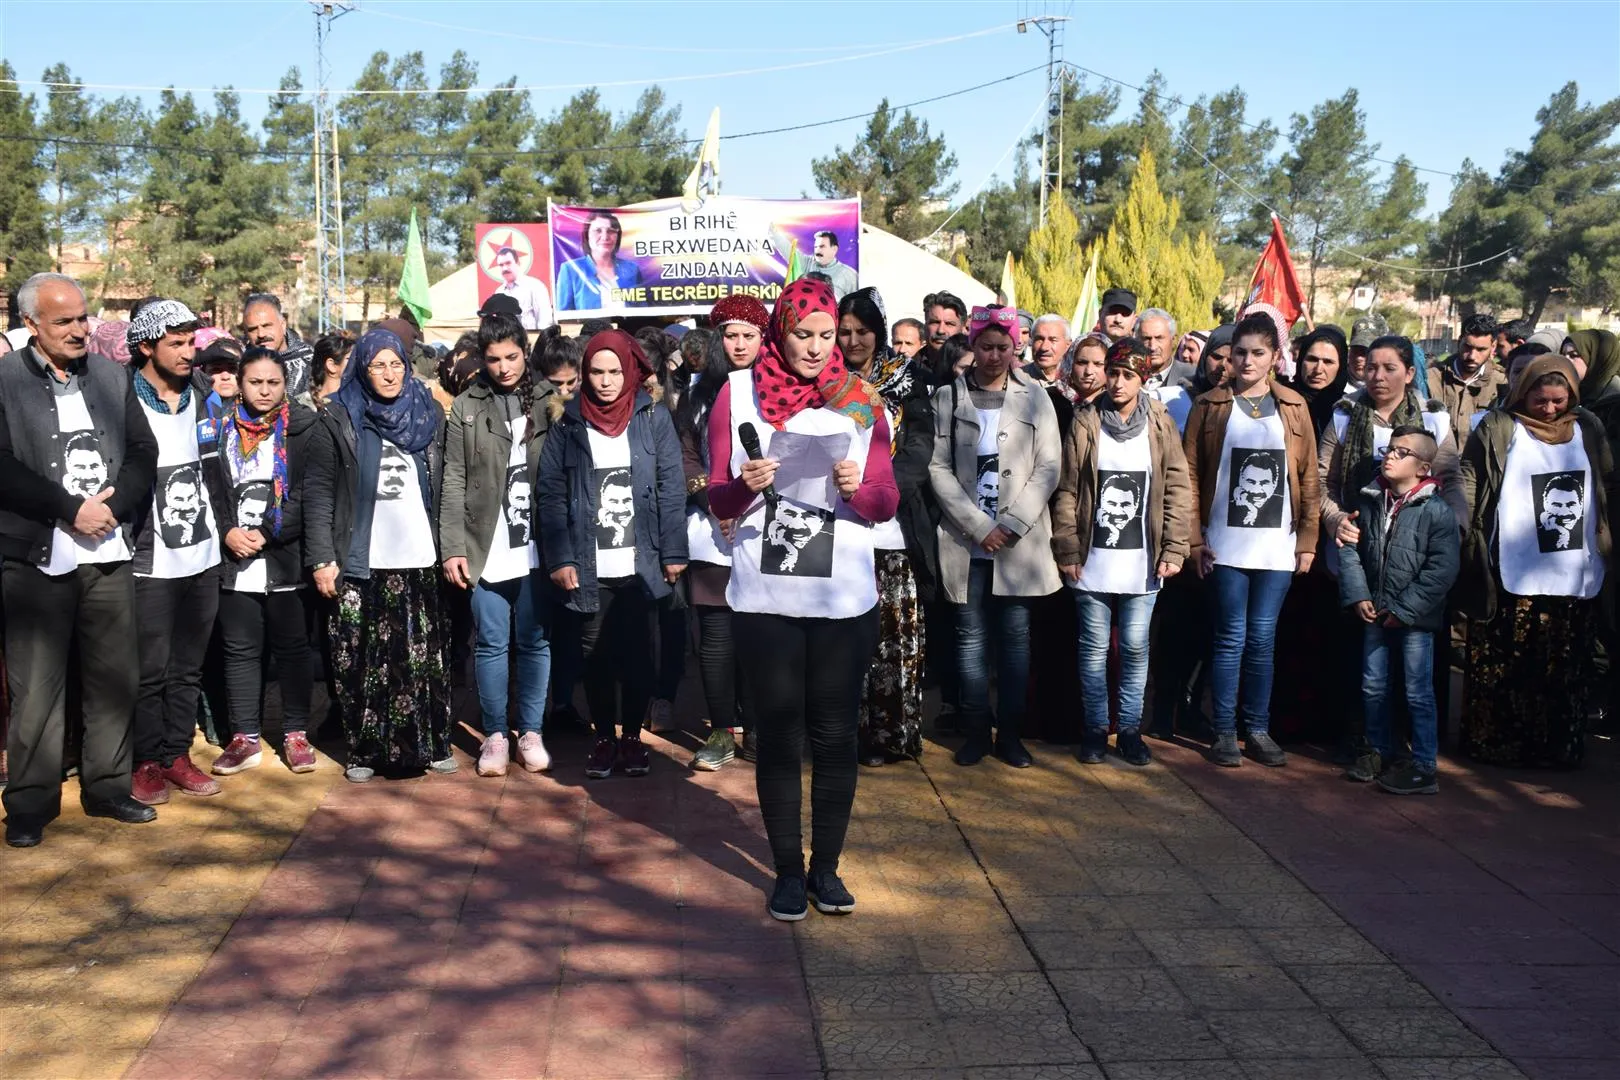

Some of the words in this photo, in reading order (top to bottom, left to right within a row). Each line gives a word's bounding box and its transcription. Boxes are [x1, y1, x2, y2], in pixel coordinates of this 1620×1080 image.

[670, 216, 687, 231] BI
[694, 211, 738, 231] RIHÊ
[635, 238, 775, 256] BERXWEDANA
[662, 261, 748, 278] ZINDANA
[650, 282, 728, 301] TECRÊDE
